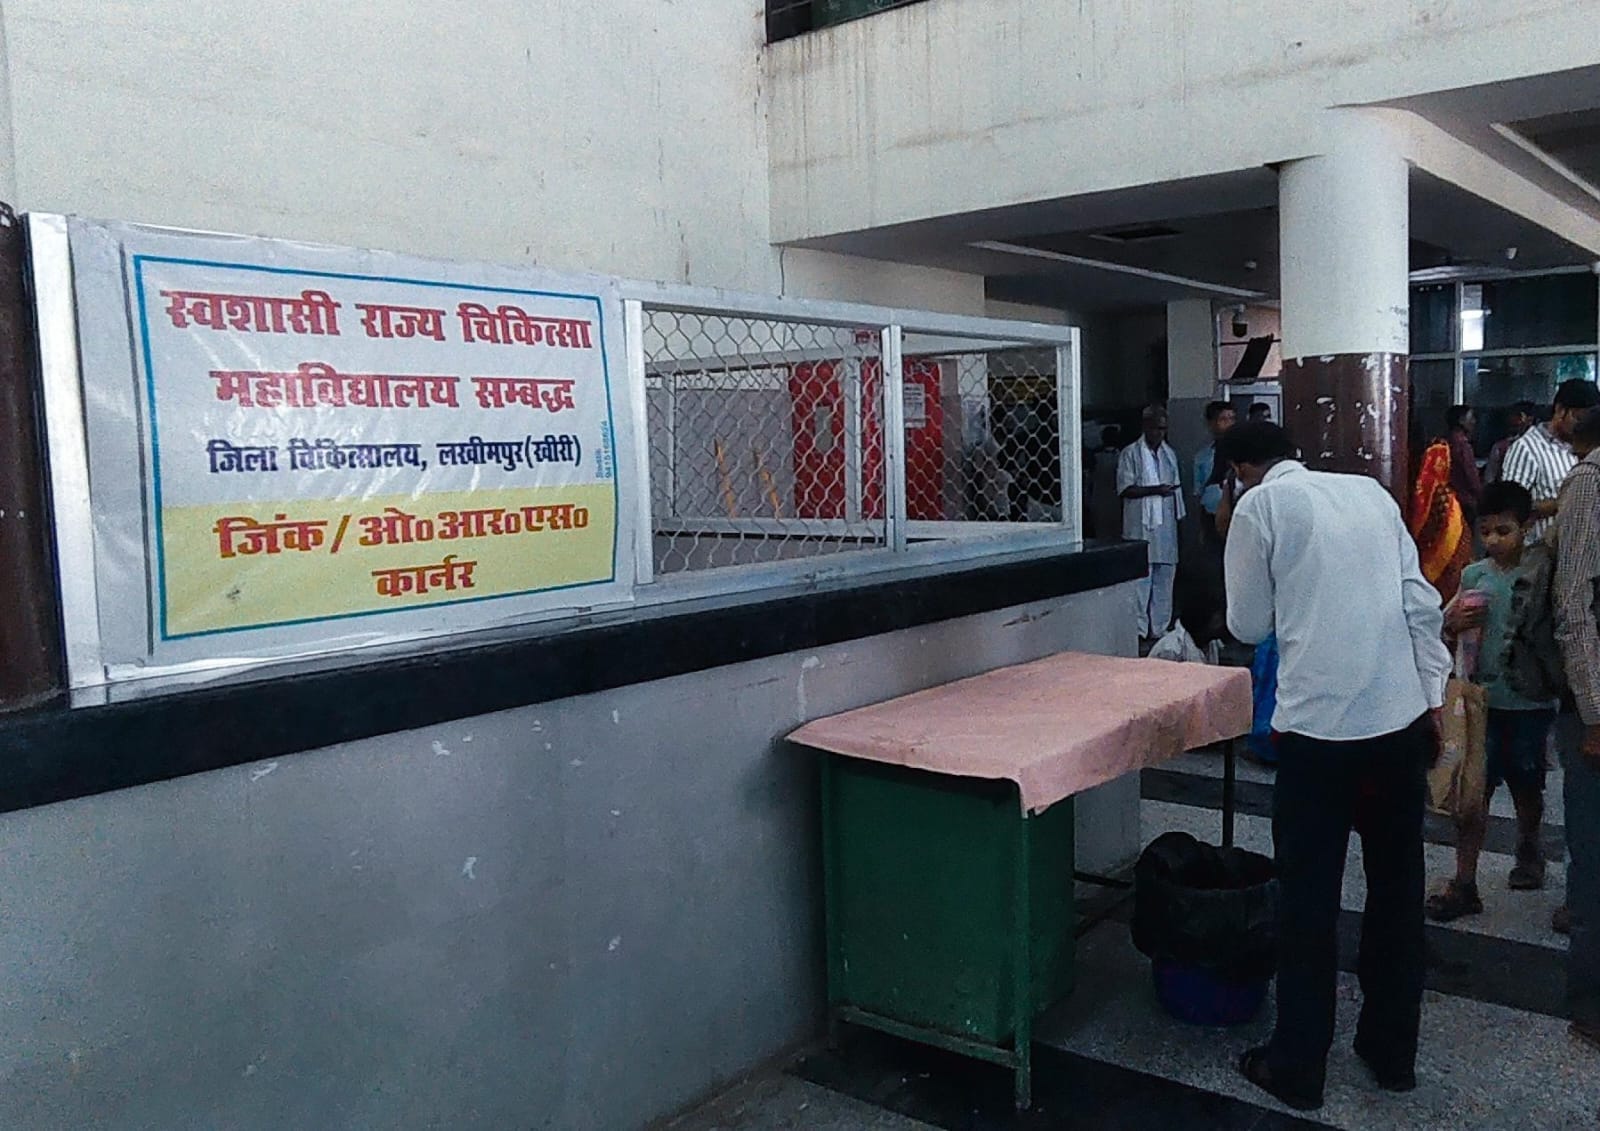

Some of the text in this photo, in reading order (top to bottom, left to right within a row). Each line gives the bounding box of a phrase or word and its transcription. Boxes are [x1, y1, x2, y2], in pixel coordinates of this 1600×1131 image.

[160, 290, 592, 349] स्वशासी राज्य चिकित्सा
[209, 362, 576, 413] महाविद्यालय सम्बद्ध
[206, 439, 279, 474] जिला
[371, 554, 478, 597] कार्नर
